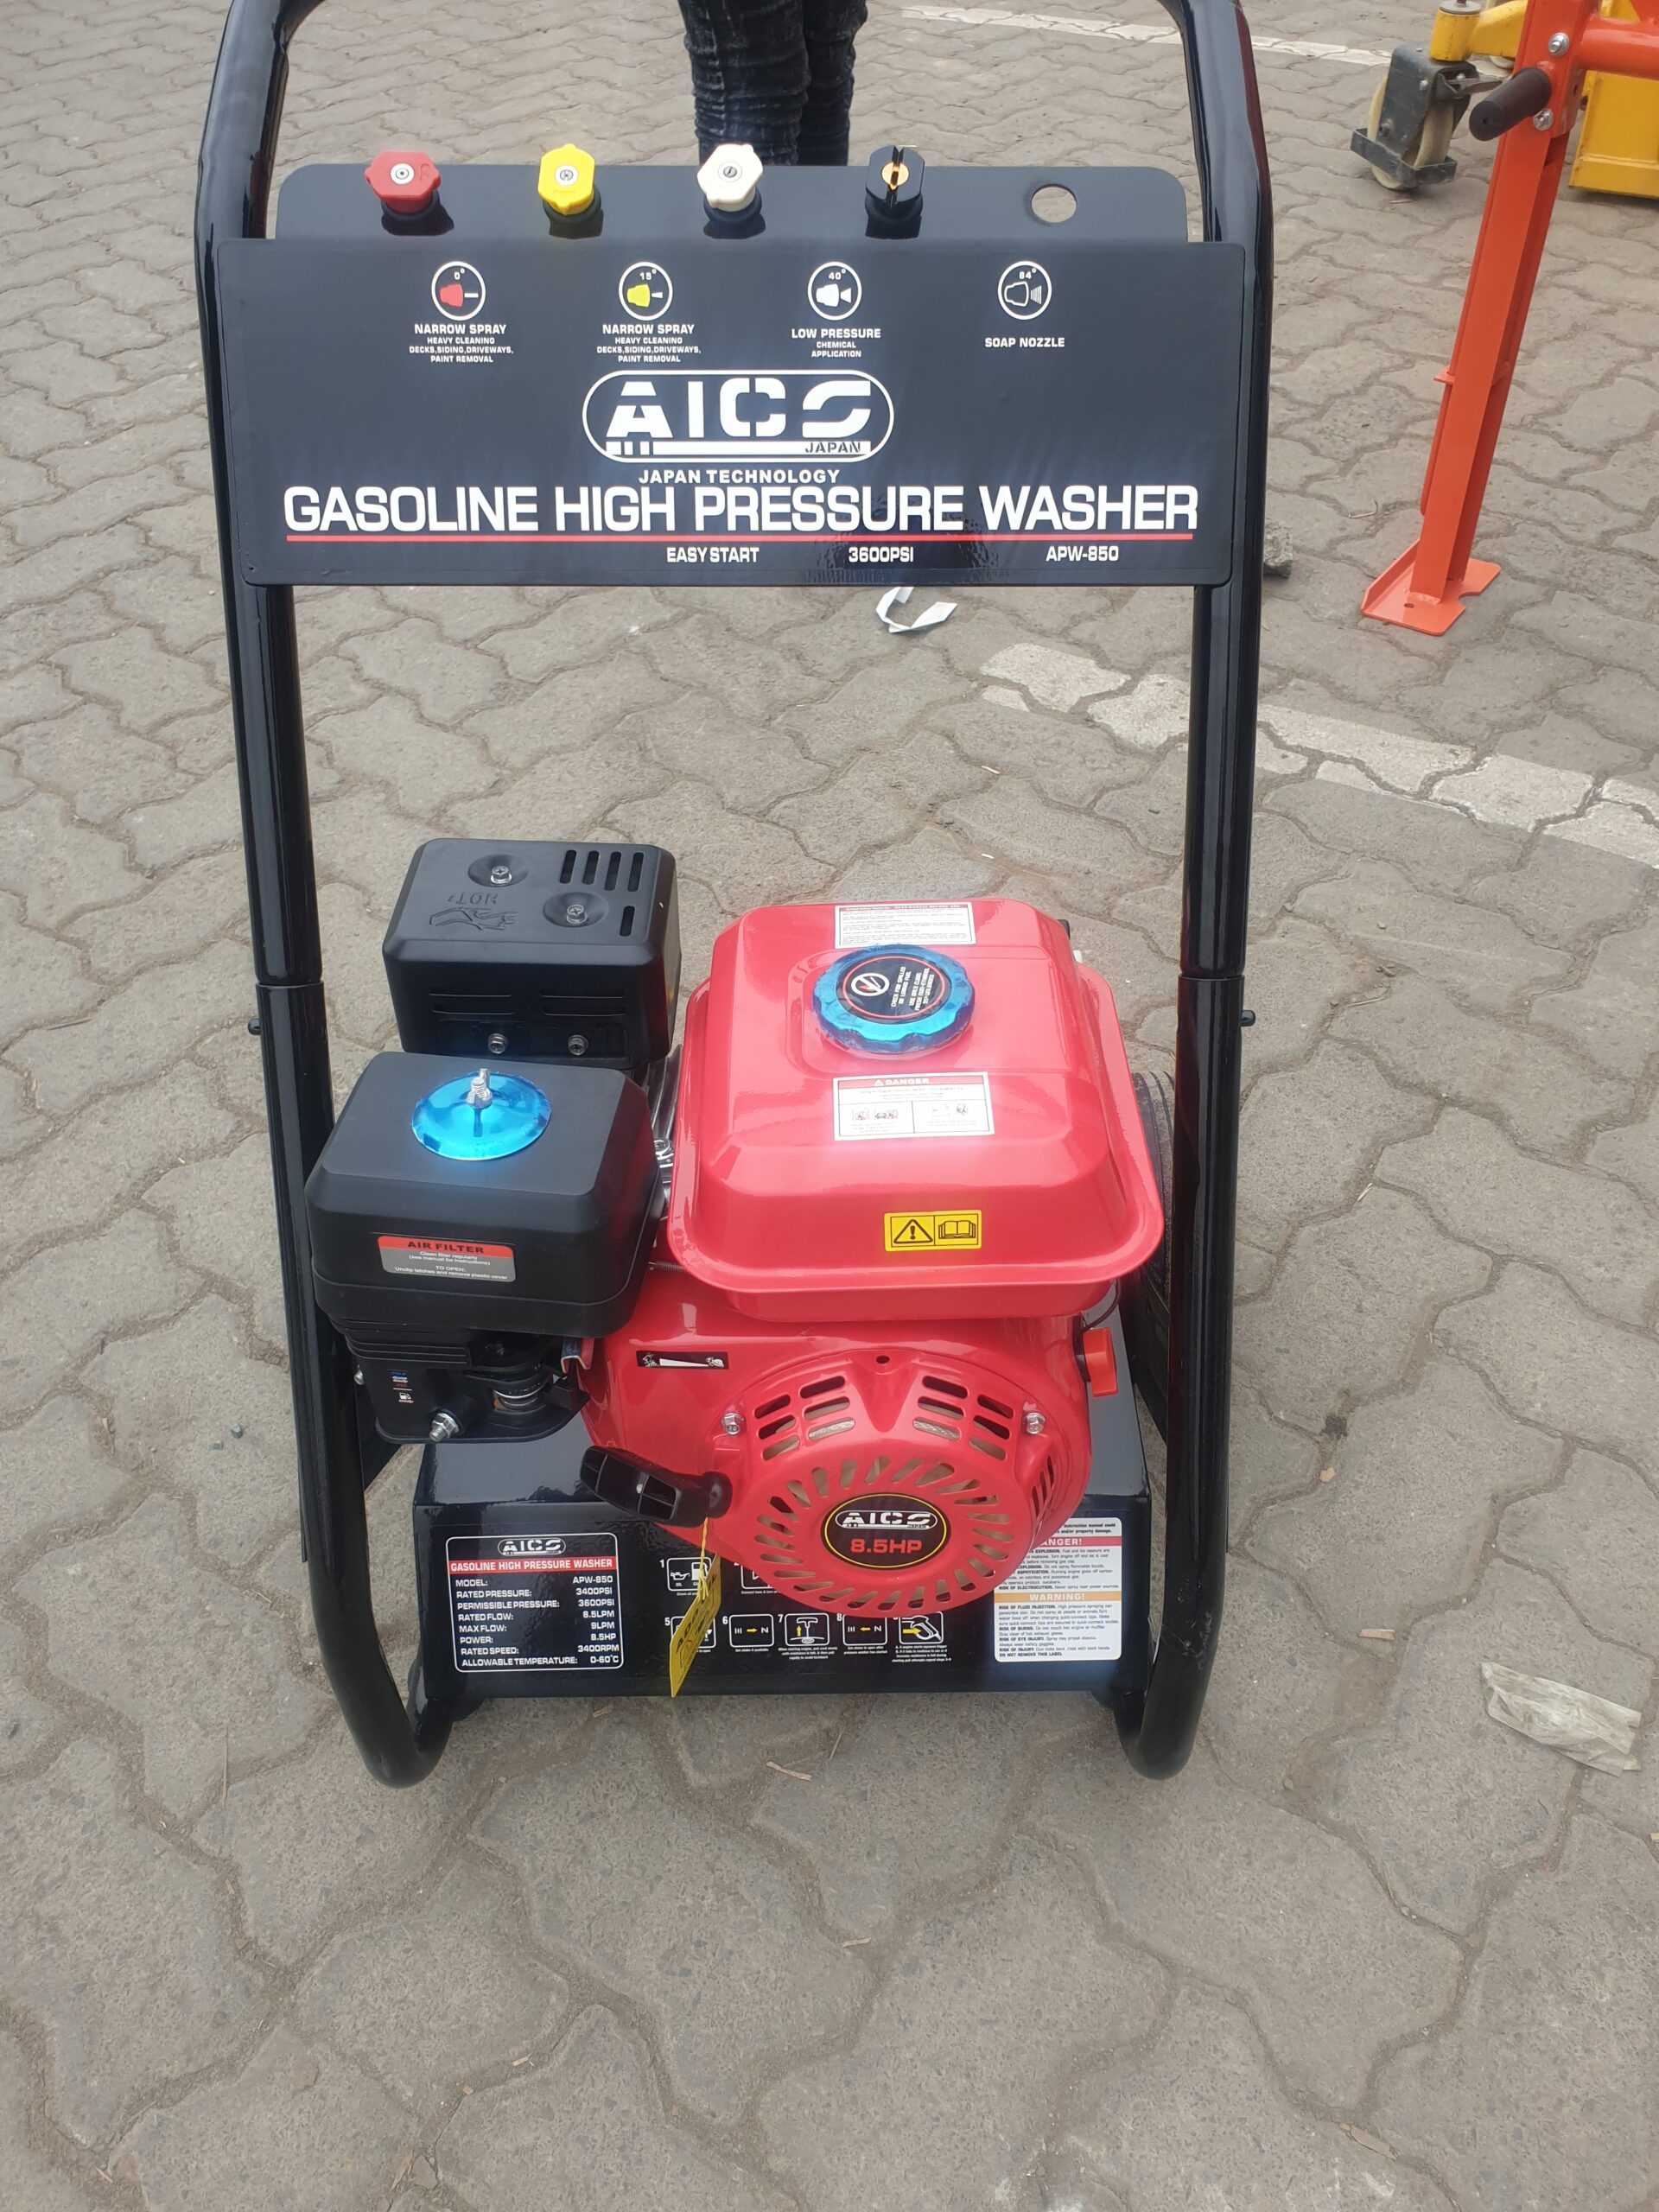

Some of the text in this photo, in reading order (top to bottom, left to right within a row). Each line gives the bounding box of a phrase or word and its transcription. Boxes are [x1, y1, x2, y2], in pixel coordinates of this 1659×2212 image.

[415, 323, 506, 335] NARROW SPRAY
[602, 323, 695, 335] NARROW SPRAY
[791, 328, 881, 339] LOW PRESSURE
[427, 337, 495, 345] HEAVY CLEANING
[615, 337, 683, 345] HEAVY CLEANING
[985, 337, 1065, 348] SOAP NOZZLE
[606, 378, 871, 438] AICS
[804, 441, 861, 454] JAPAN
[639, 469, 840, 485] JAPAN TECHNOLOGY
[283, 485, 1198, 532] GASOLINE HIGH PRESSURE WASHER
[666, 546, 760, 563] EASY START
[848, 546, 914, 563] 3600PSI
[1046, 545, 1119, 563] APW-850
[407, 1241, 484, 1253] AIR FILTER
[842, 1512, 931, 1524] AICS
[503, 1539, 562, 1552] AICS
[850, 1538, 923, 1554] 8.5HP
[451, 1559, 613, 1572] GASOLINE HIGH PRESSURE WASHER
[660, 1559, 665, 1568] 1
[572, 1576, 613, 1584] APW-850
[457, 1602, 512, 1610] PERMISSIBLE
[513, 1600, 559, 1608] PRESSURE:
[664, 1618, 670, 1626] 5
[722, 1616, 728, 1625] 6
[778, 1614, 783, 1623] 7
[578, 1644, 619, 1653] 3400RPM
[462, 1658, 513, 1666] ALLOWABLE
[514, 1657, 578, 1665] TEMPERATURE:
